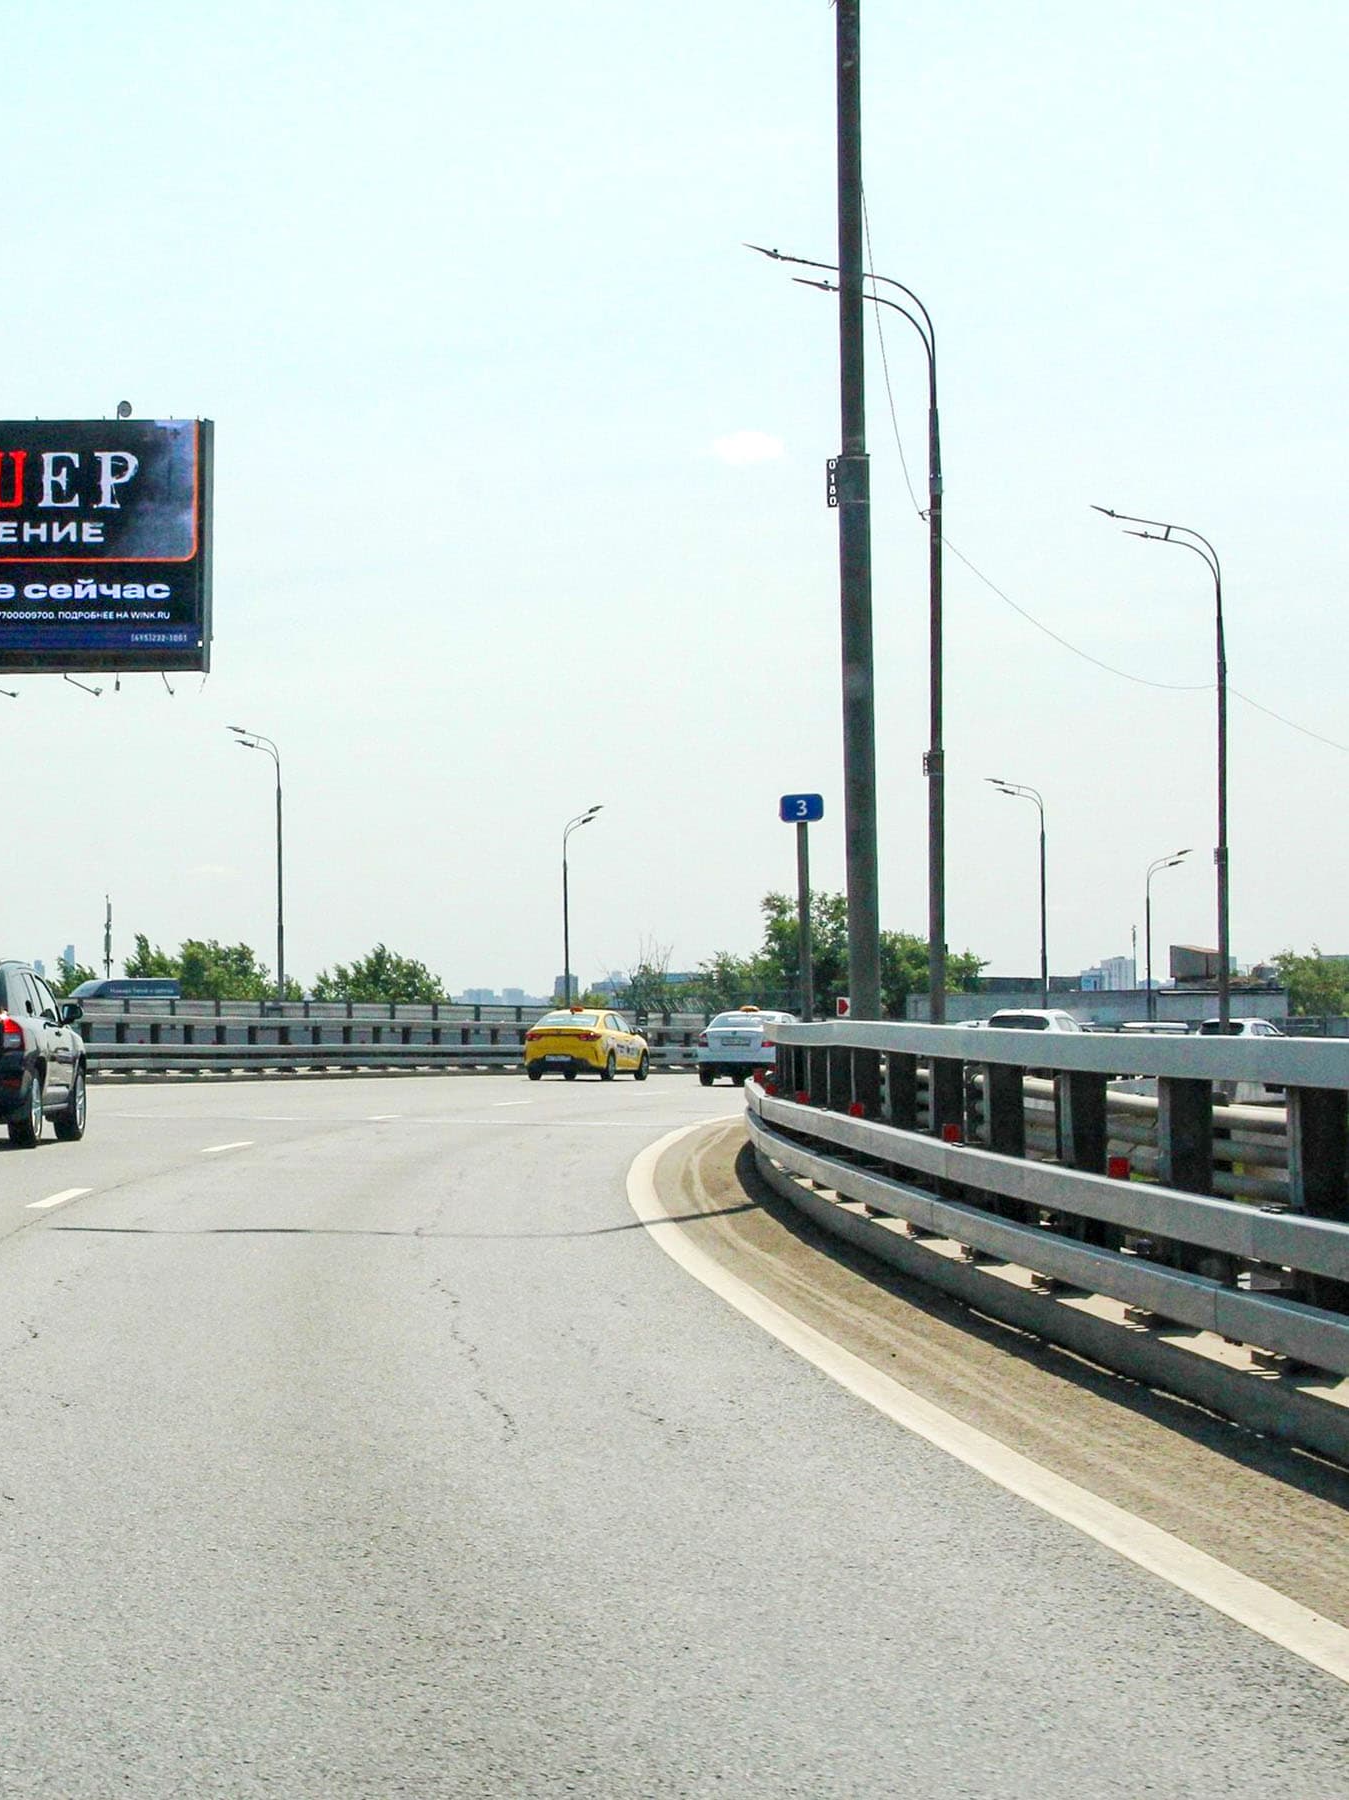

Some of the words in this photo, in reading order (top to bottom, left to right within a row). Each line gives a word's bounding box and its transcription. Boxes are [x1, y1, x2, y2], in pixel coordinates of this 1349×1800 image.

[23, 579, 171, 600] сейчас
[58, 611, 114, 620] ПОДРОБНЕЕ
[116, 611, 129, 619] НА
[131, 611, 170, 619] WINK.RU
[796, 800, 808, 816] 3
